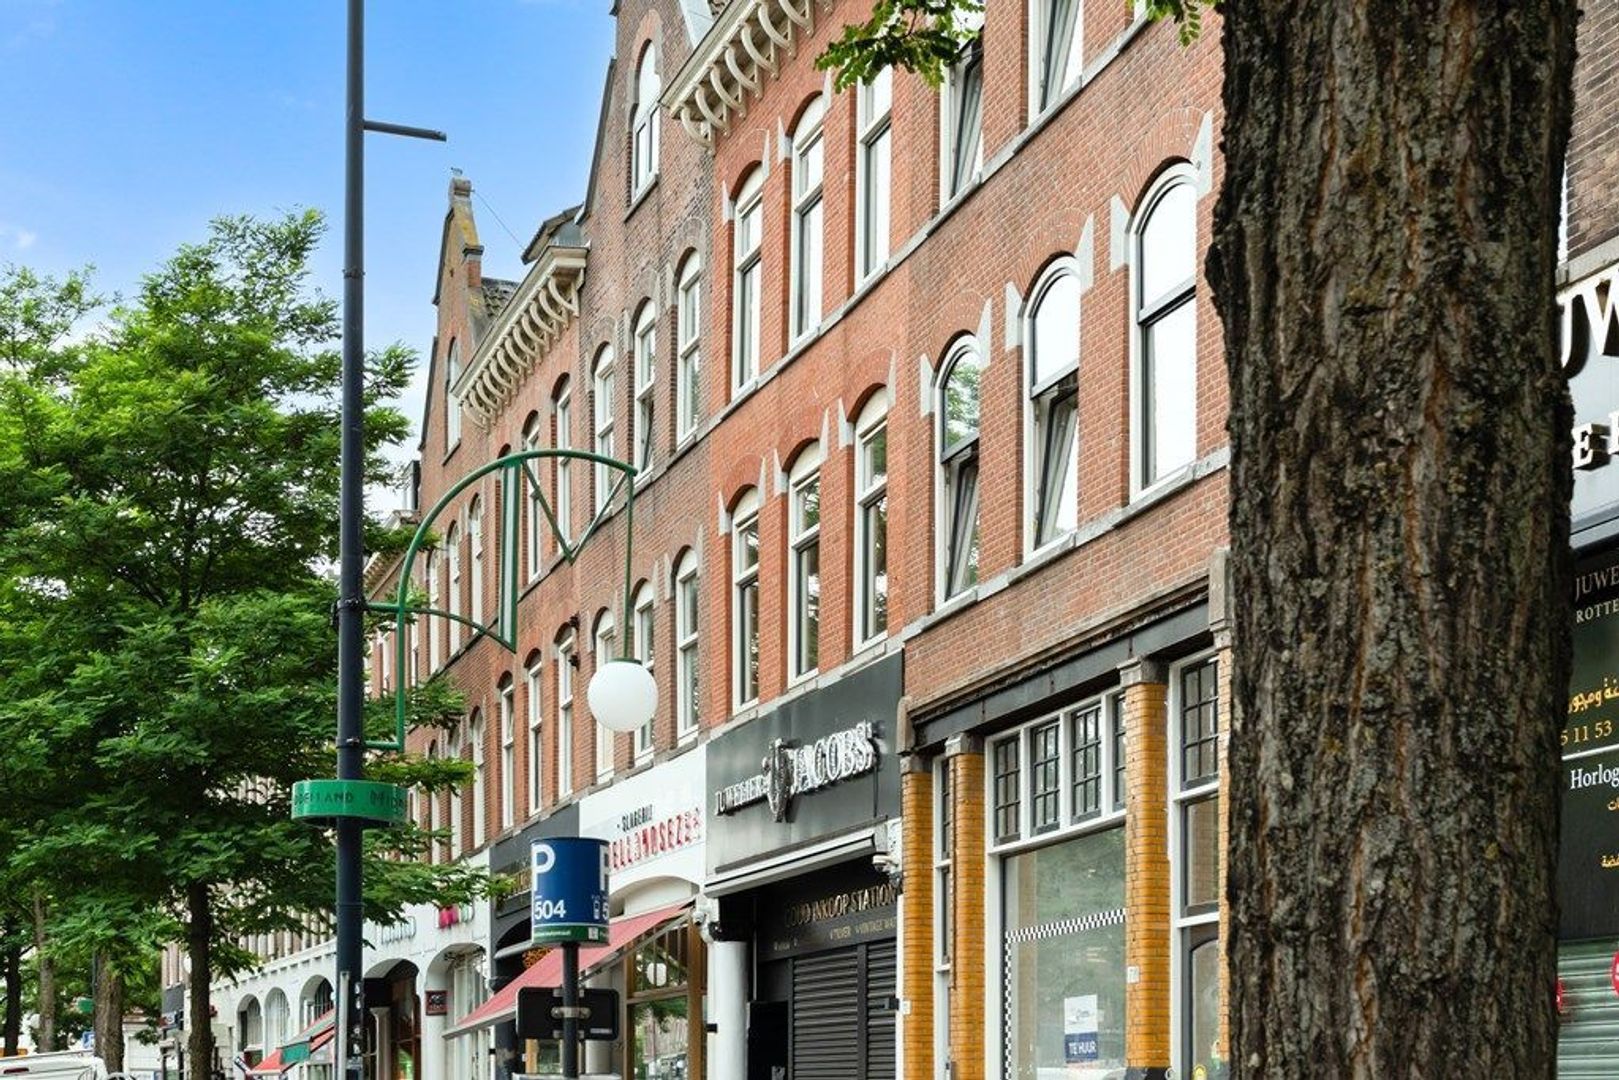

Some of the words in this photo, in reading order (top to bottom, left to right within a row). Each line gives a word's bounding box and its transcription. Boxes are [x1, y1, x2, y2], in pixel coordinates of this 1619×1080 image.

[1576, 598, 1619, 623] ROTTE
[1574, 726, 1588, 743] 11
[1595, 720, 1612, 738] 53
[787, 720, 873, 794] JACOBS
[1570, 764, 1619, 789] Horlog
[532, 843, 556, 892] P
[534, 899, 567, 920] 504
[850, 883, 897, 913] STATION
[602, 901, 610, 921] 5
